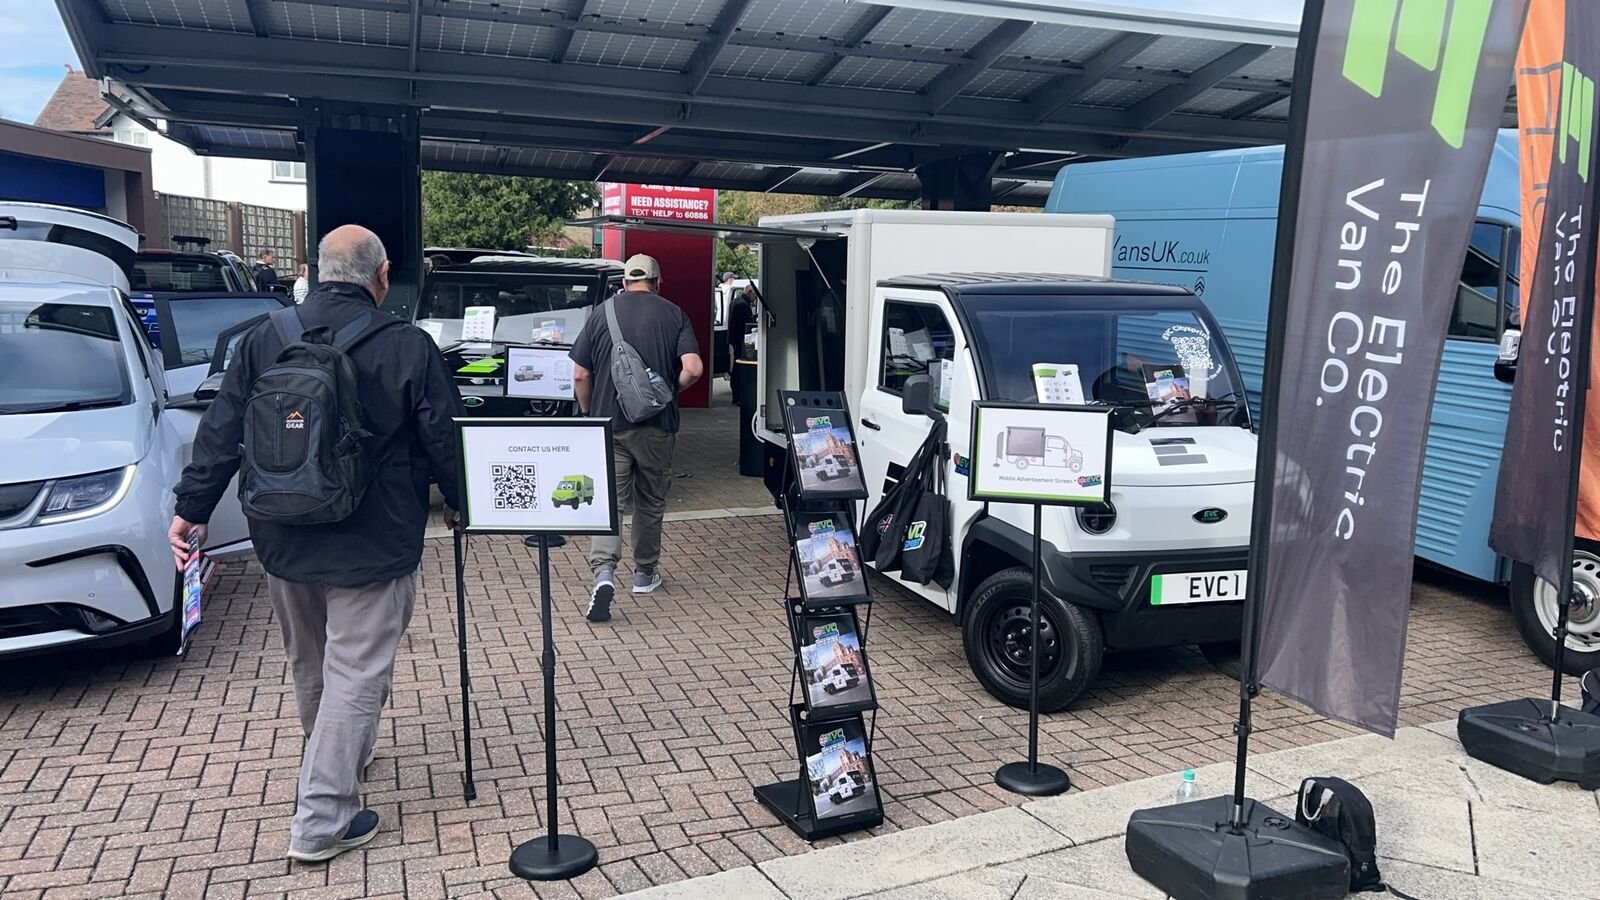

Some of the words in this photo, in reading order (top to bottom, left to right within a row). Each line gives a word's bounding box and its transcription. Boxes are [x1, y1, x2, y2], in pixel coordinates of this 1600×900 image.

[631, 195, 653, 207] NEED
[653, 197, 709, 210] ASSISTANCE?
[631, 208, 650, 217] TEXT
[1334, 178, 1385, 291] Van
[1381, 178, 1431, 295] The
[1315, 310, 1365, 407] Co.
[1334, 314, 1407, 541] Electric
[1189, 575, 1229, 598] EVC
